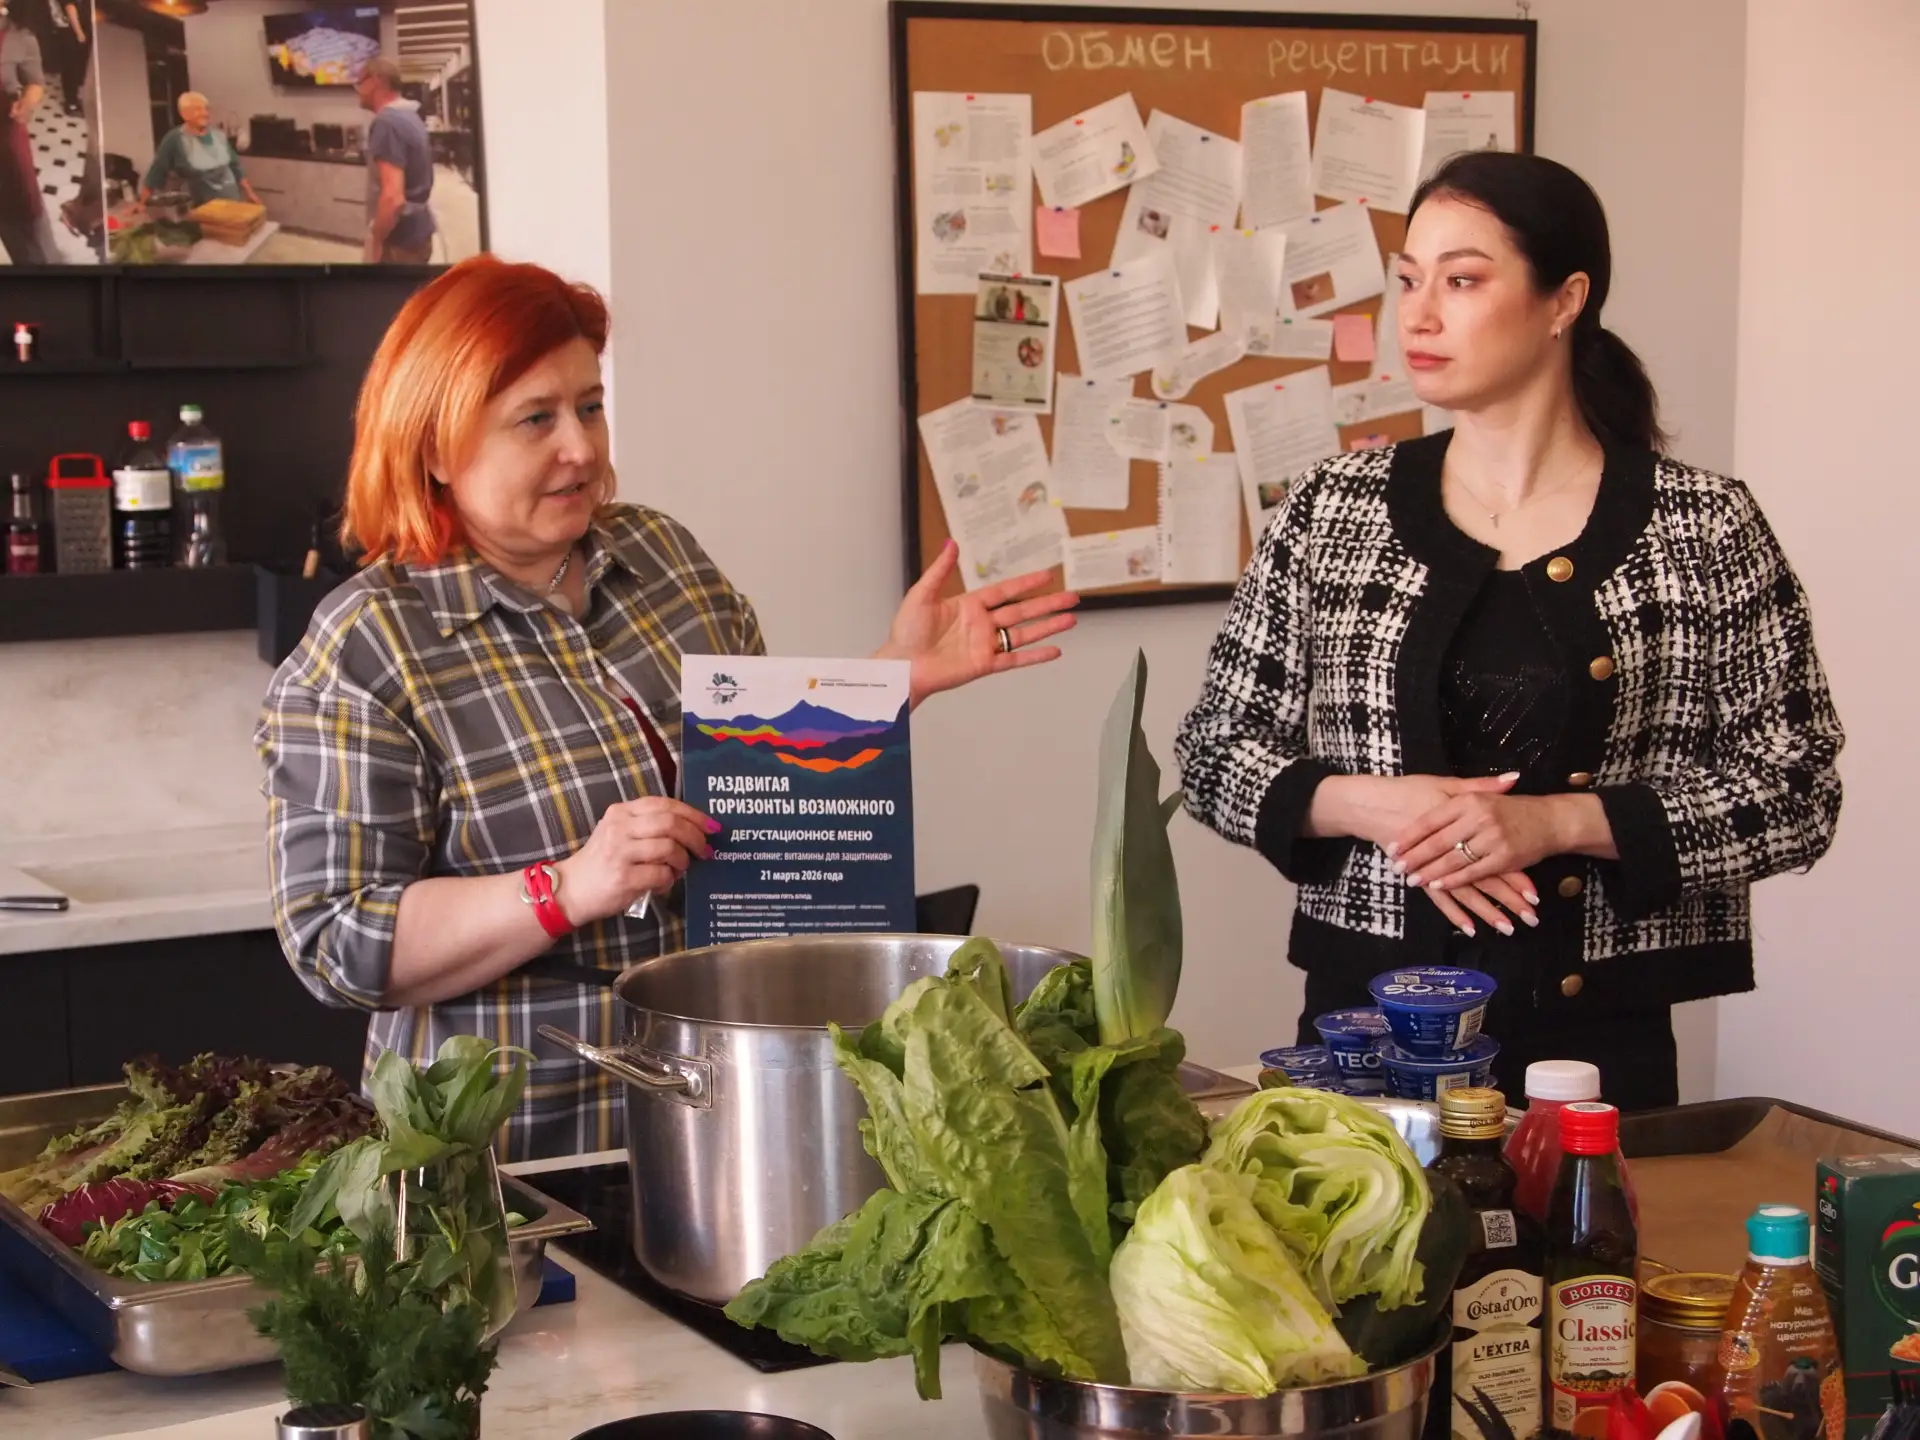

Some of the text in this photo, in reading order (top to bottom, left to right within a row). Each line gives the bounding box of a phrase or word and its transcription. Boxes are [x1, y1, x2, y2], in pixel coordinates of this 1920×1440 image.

[1268, 39, 1509, 79] рецептами
[707, 776, 790, 794] РАЗДВИГАЯ
[709, 798, 895, 816] ГОРИЗОНТЫ ВОЗМОЖНОГО
[730, 829, 873, 842] ДЕГУСТАЦИОННОЕ МЕНЮ
[713, 850, 893, 863] Северное сияние: витамины для защитников»
[760, 870, 843, 883] 21 марта 2026 года
[1333, 1050, 1381, 1069] TEO
[1820, 1199, 1837, 1219] Gallo
[1569, 1284, 1630, 1301] BORGES
[1792, 1286, 1813, 1297] fresh
[1467, 1301, 1502, 1320] Costa
[1558, 1318, 1635, 1341] Classic
[1473, 1340, 1530, 1358] L'EXTRA
